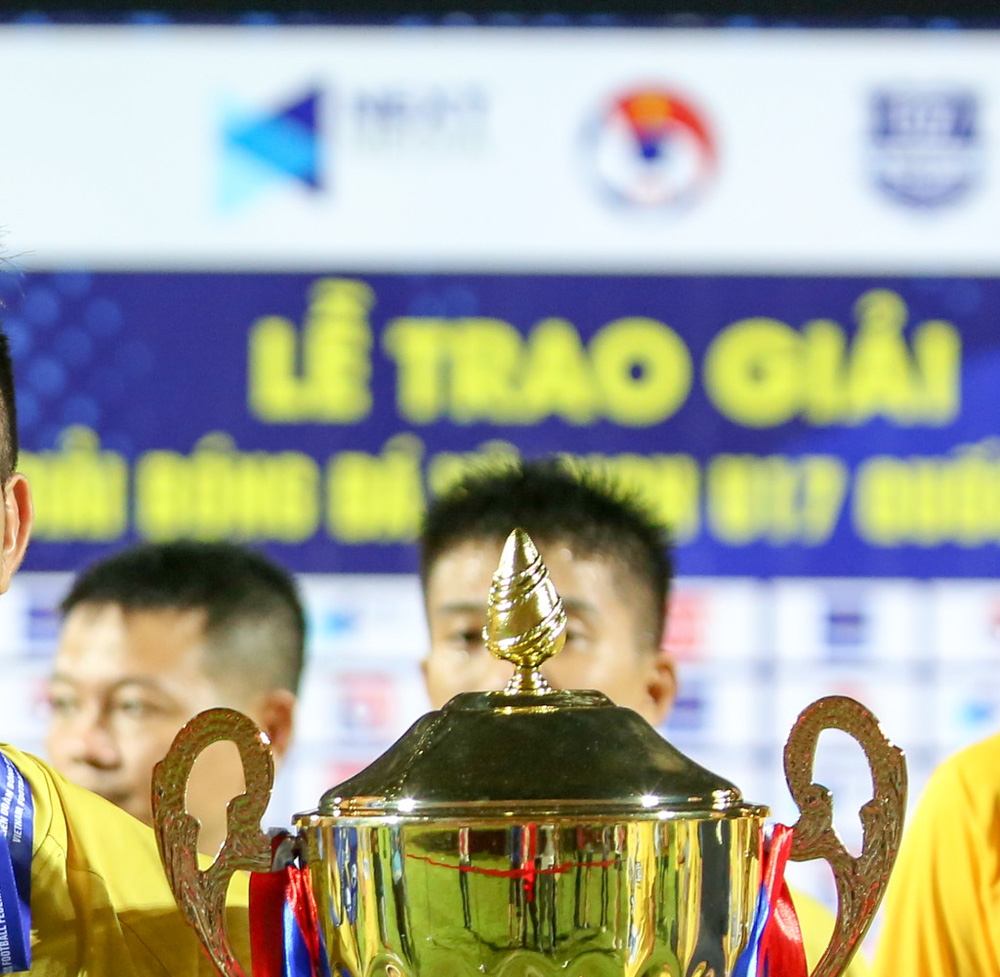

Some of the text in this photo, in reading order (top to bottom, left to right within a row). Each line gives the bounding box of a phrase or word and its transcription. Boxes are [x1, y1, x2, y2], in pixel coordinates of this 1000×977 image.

[384, 316, 691, 425] TRAO
[704, 288, 961, 426] GIẢI
[12, 805, 24, 843] VIETNAM
